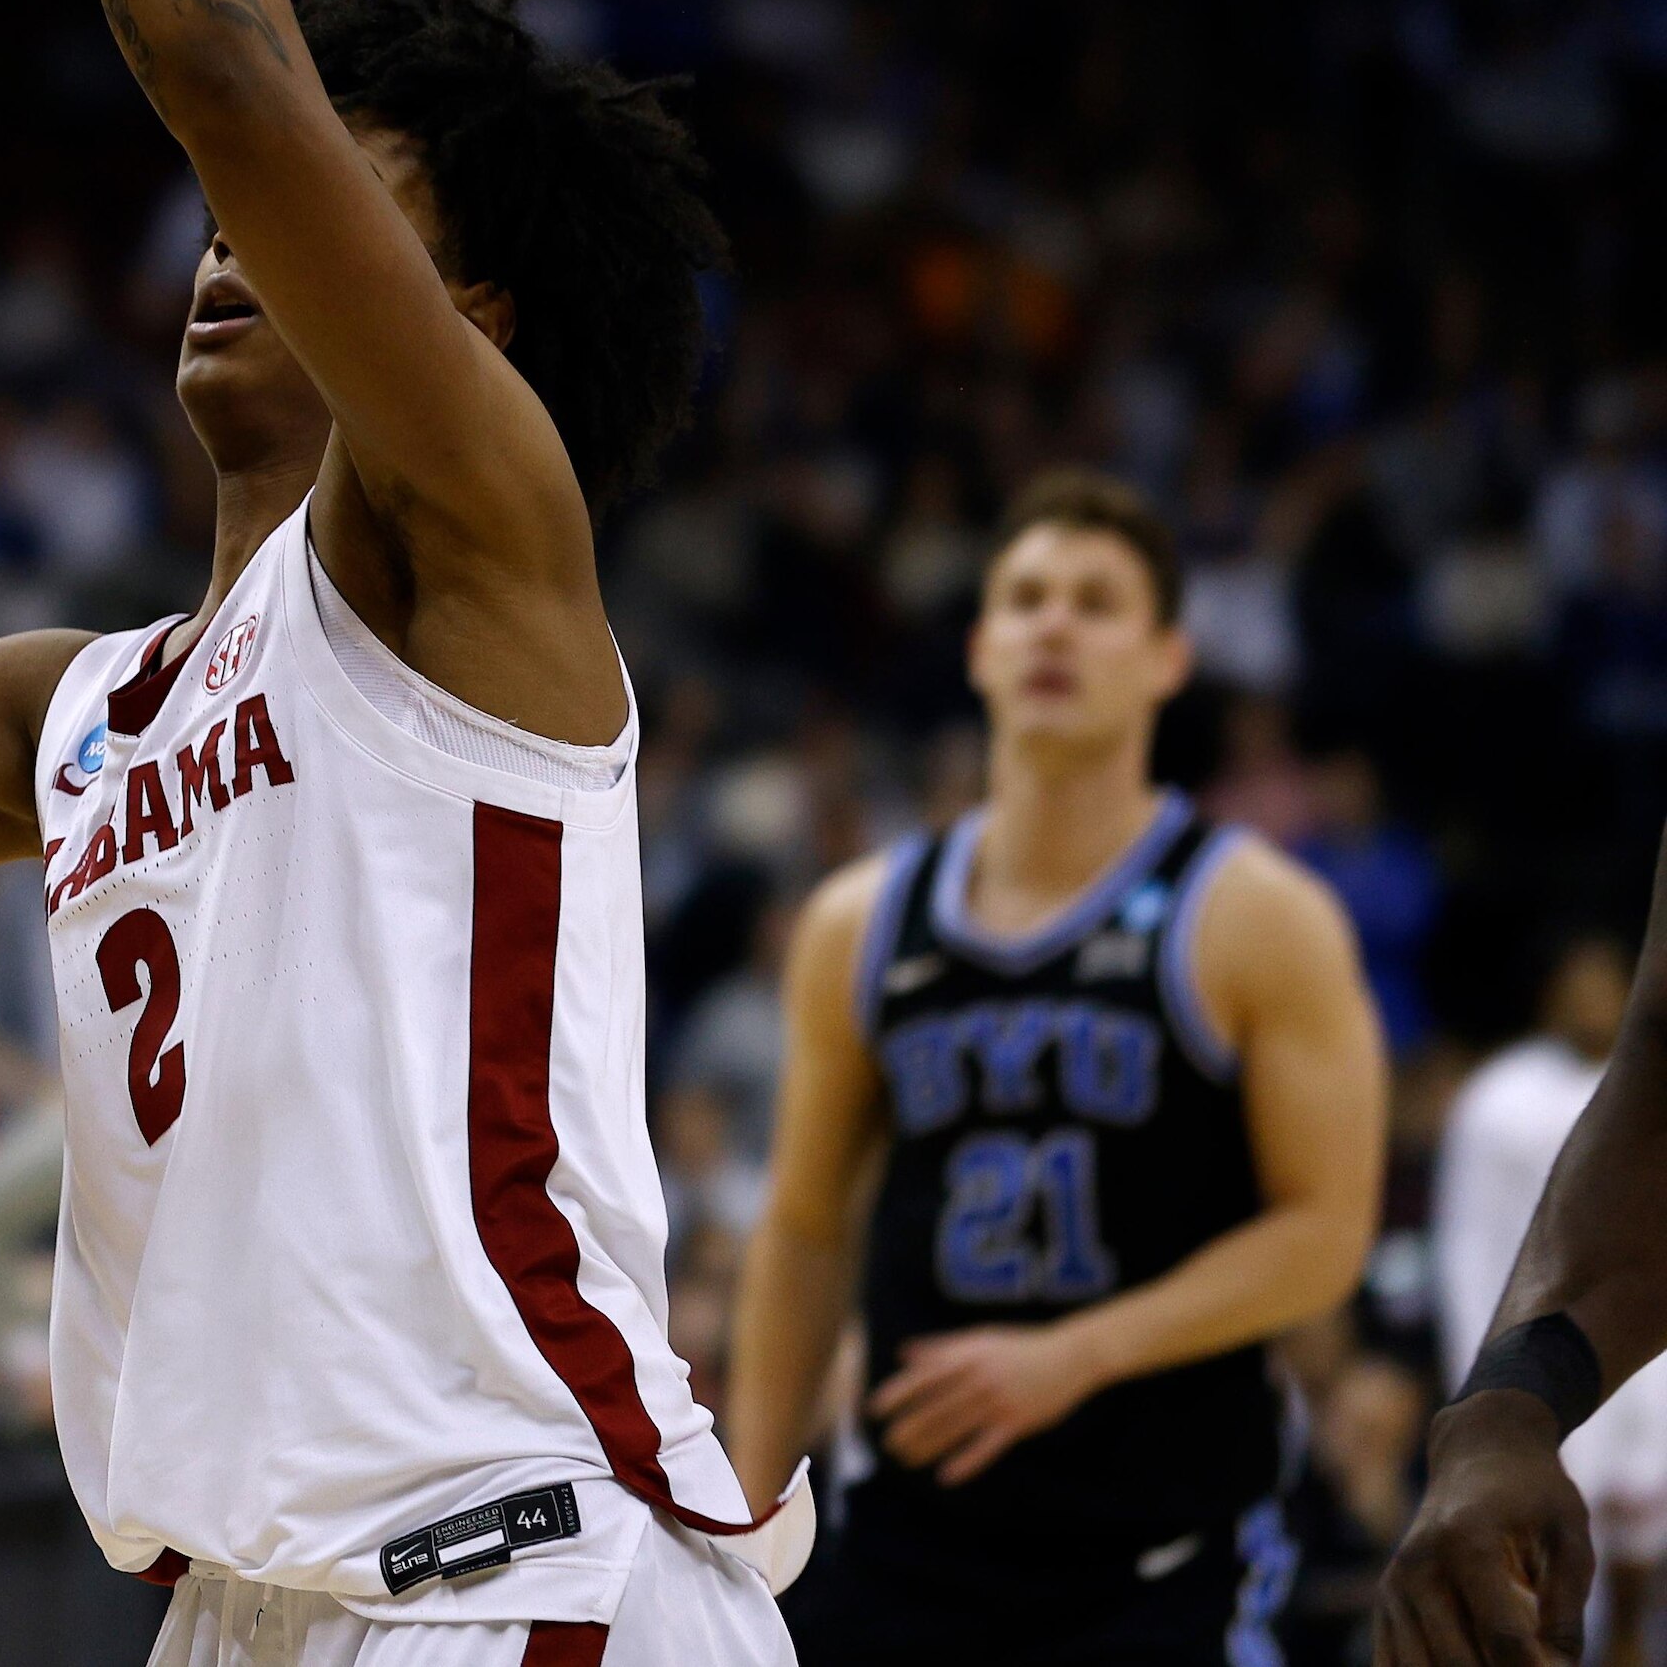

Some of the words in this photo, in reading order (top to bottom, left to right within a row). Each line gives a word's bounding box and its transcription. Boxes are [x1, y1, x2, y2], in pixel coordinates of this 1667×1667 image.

[95, 907, 186, 1148] 2
[881, 1003, 1160, 1133] BYU
[939, 1134, 1116, 1300] 21
[434, 1508, 500, 1536] ENGINEERED
[516, 1508, 548, 1530] 44
[392, 1552, 429, 1575] ELITE
